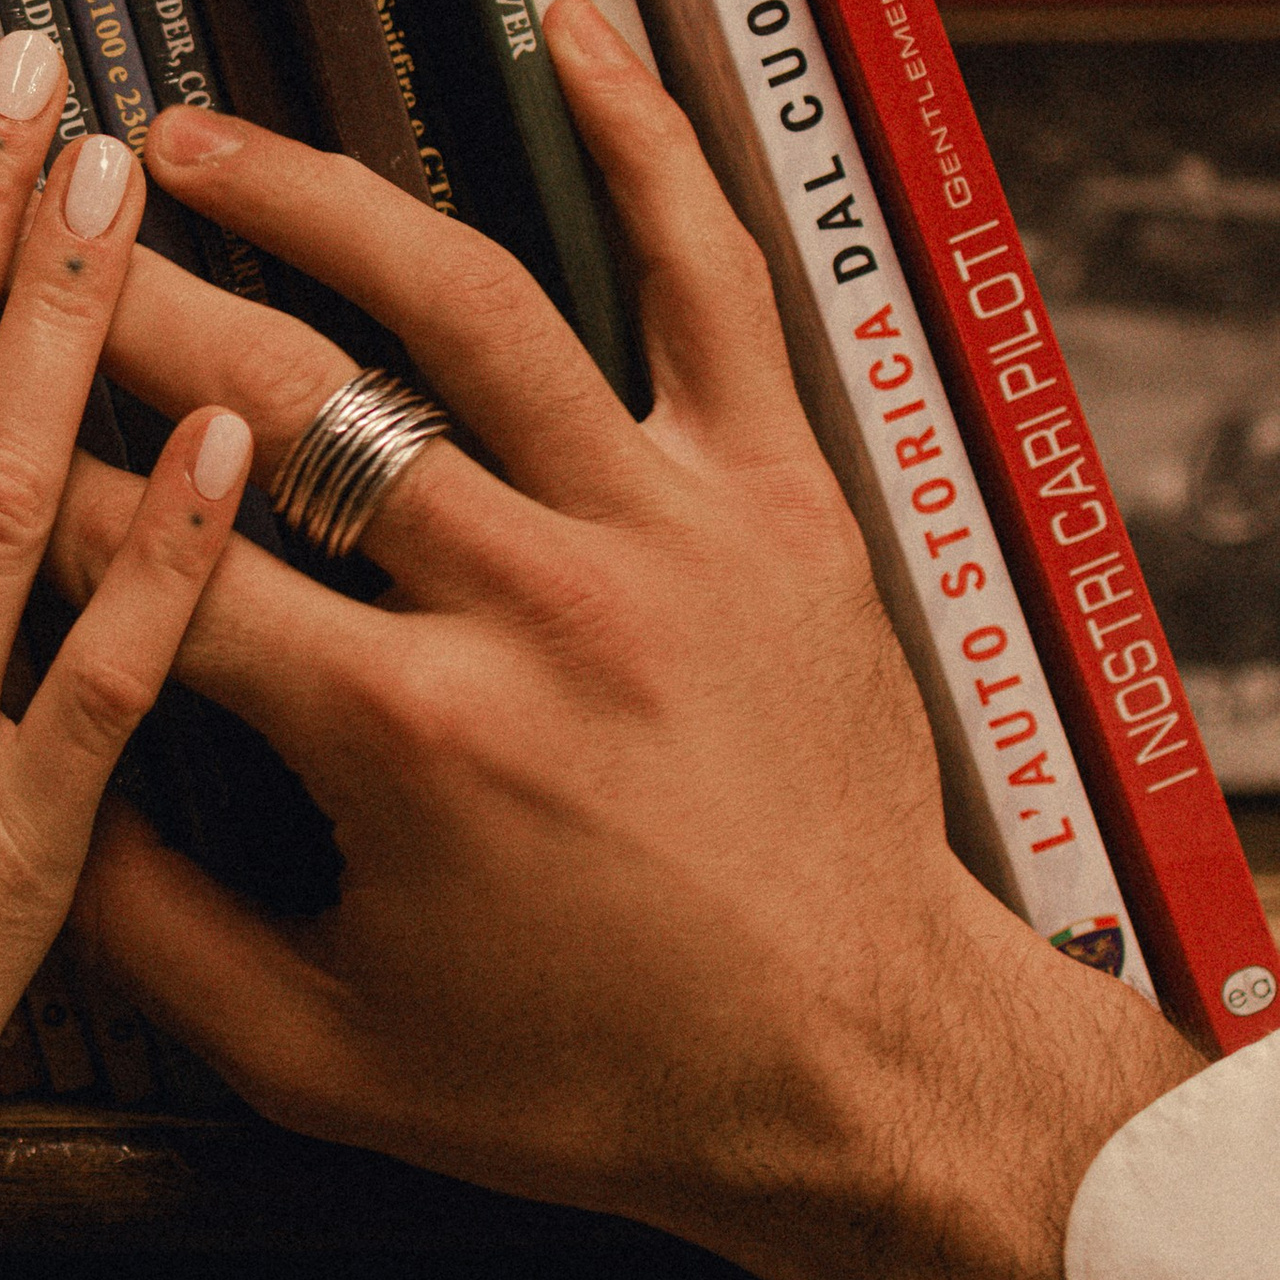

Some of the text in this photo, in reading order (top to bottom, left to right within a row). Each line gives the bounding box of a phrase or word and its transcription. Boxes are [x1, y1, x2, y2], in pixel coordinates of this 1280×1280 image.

[108, 66, 128, 84] e
[178, 71, 211, 109] CO
[814, 153, 880, 285] DAL
[947, 219, 1069, 403] PILOTI
[853, 301, 989, 601] STORICA
[1022, 405, 1109, 548] CARI
[1068, 551, 1192, 767] NOSTRI
[960, 625, 1077, 855] L'AUTO
[1145, 766, 1200, 794] I
